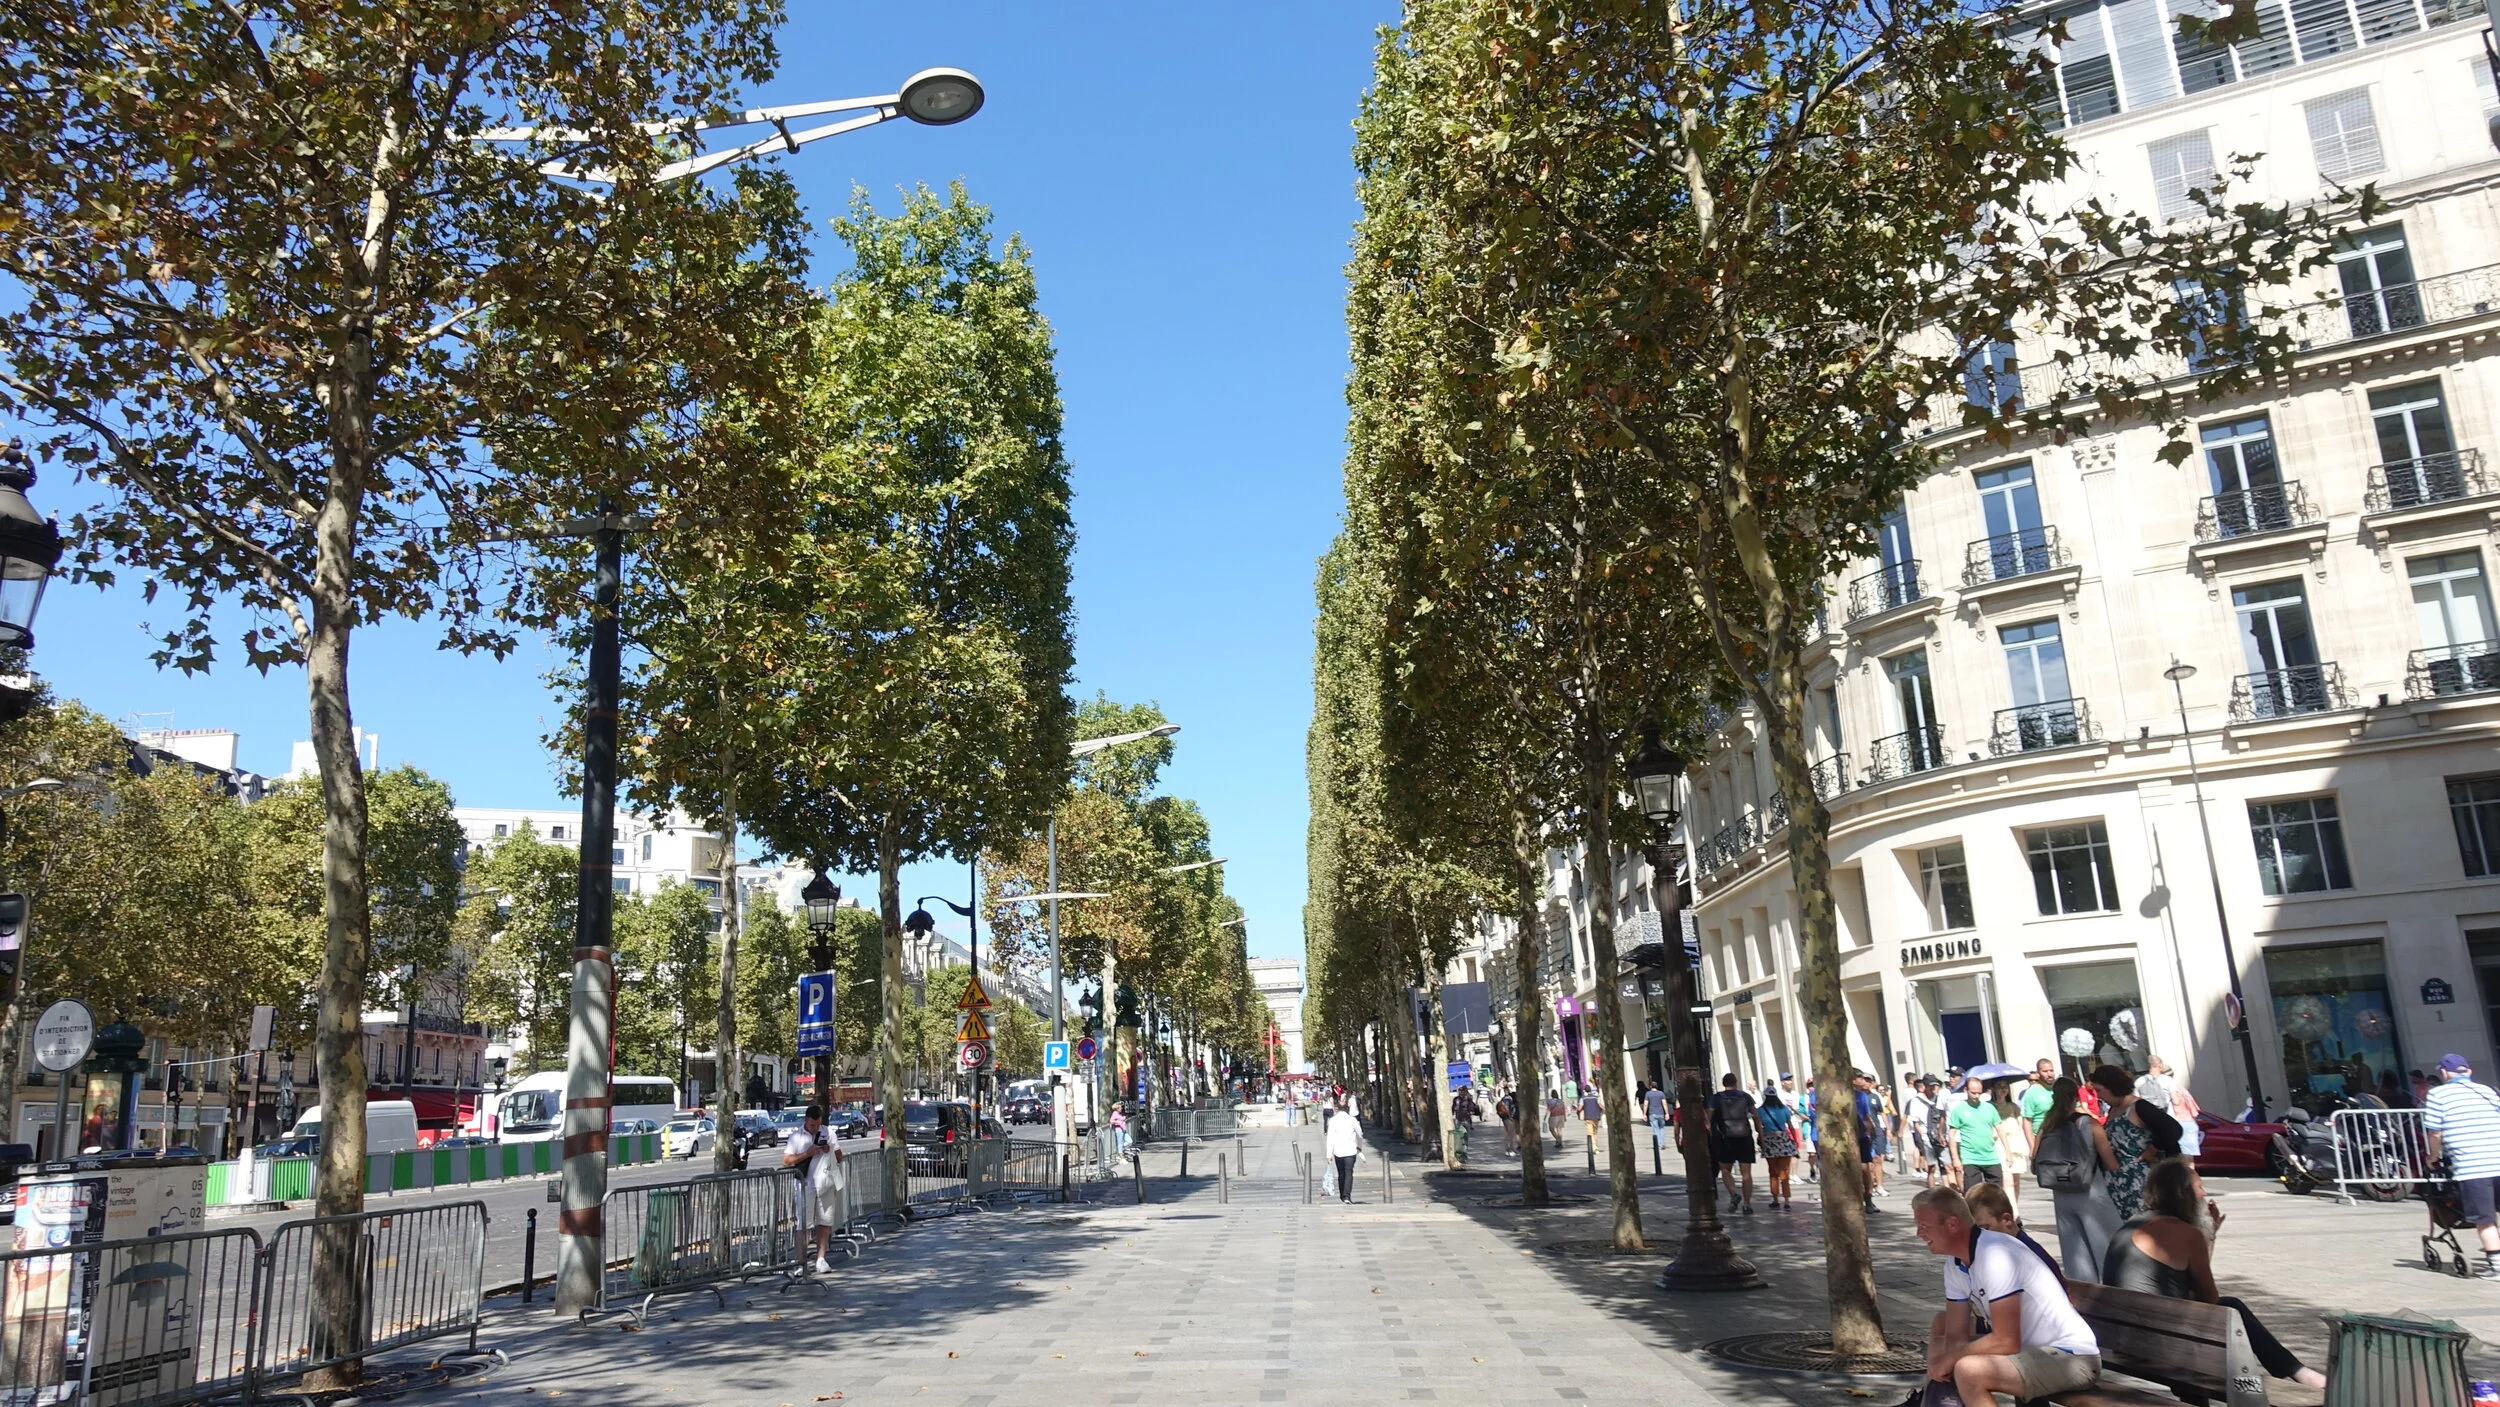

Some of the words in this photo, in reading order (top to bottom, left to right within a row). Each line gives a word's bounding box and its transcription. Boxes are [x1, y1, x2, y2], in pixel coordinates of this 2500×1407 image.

[1901, 938, 1981, 964] SAMSUNG
[808, 982, 825, 1015] P
[966, 1048, 981, 1060] 30
[1051, 1047, 1063, 1064] P
[191, 1180, 203, 1191] 05
[190, 1207, 201, 1218] 02
